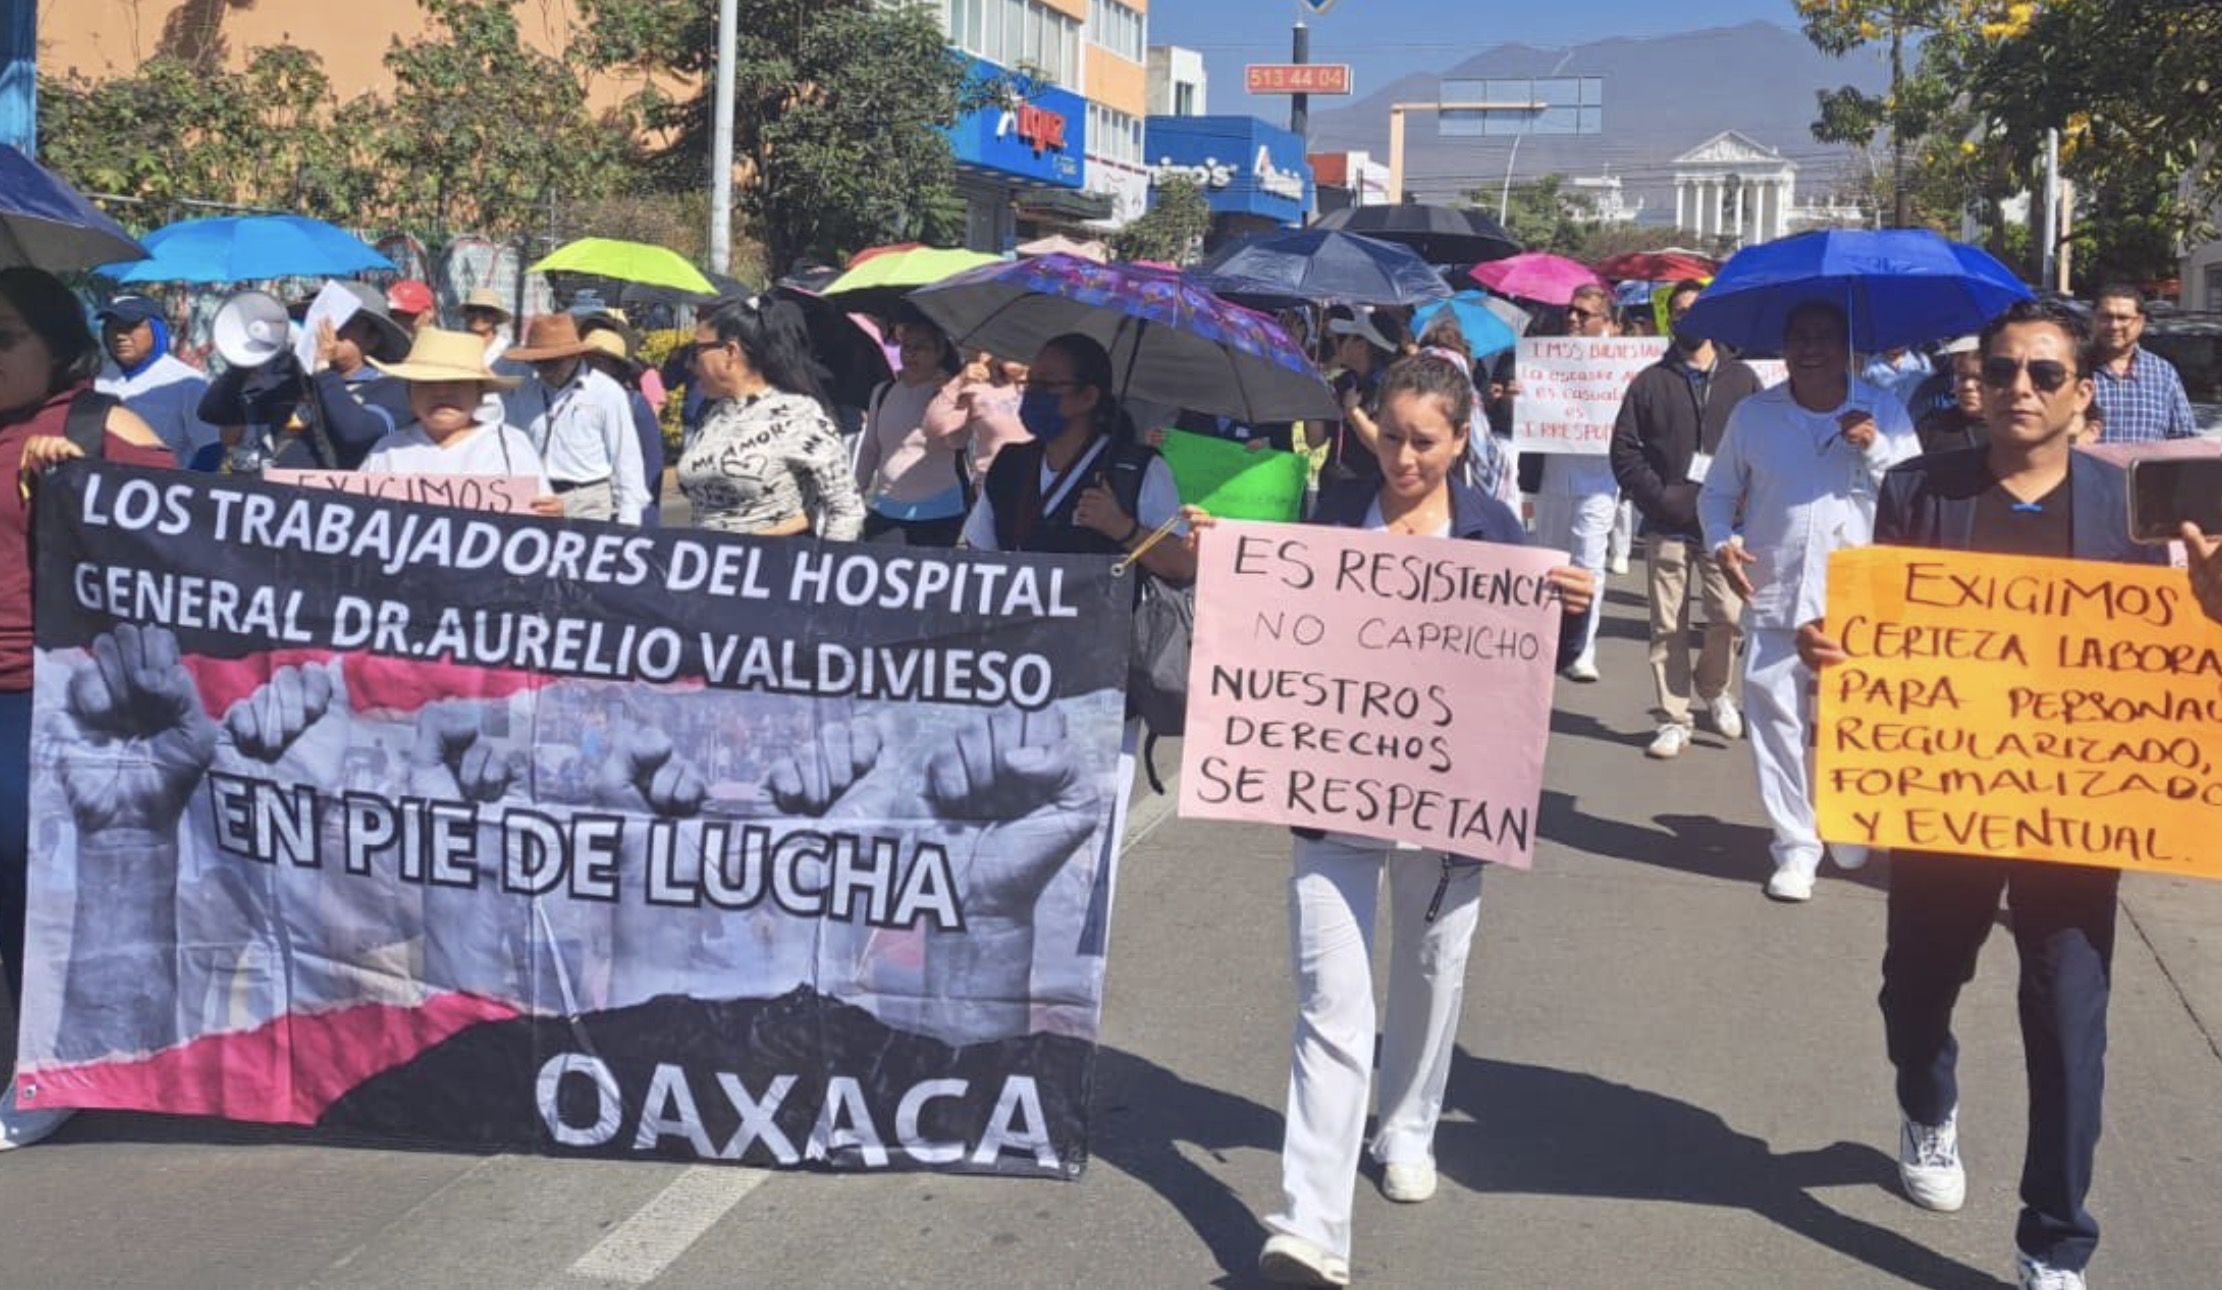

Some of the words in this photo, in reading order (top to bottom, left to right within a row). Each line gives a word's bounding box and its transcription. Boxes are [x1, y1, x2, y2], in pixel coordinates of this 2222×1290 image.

[1290, 69, 1312, 86] 44
[1319, 69, 1341, 86] 04
[82, 473, 190, 538] LOS
[210, 489, 653, 584] TRABAJADORES
[666, 540, 770, 598] DEL
[789, 552, 1078, 617] HOSPITAL
[1234, 535, 1314, 590] ES
[1905, 562, 2178, 627] EXIGIMOS
[74, 561, 312, 642] GENERAL
[332, 596, 683, 680] DR.AURELIO
[700, 631, 1053, 702] VALDIVIESO
[1254, 612, 1325, 645] NO
[1358, 617, 1539, 661] CAPRICHO
[1841, 615, 2029, 667] CERTEZA
[1211, 664, 1453, 727] NUESTROS
[1839, 668, 1962, 714] PARA
[1225, 716, 1453, 773] DERECHOS
[1836, 717, 2212, 776] REGULARIZADO,
[1197, 756, 1266, 802] SE
[1287, 770, 1529, 851] RESPETAN
[1853, 811, 1881, 842] Y
[209, 772, 322, 868] EN
[344, 791, 479, 891] PIE
[500, 806, 624, 902] DE
[645, 817, 968, 932] LUCHA
[535, 1052, 1060, 1169] OAXACA
